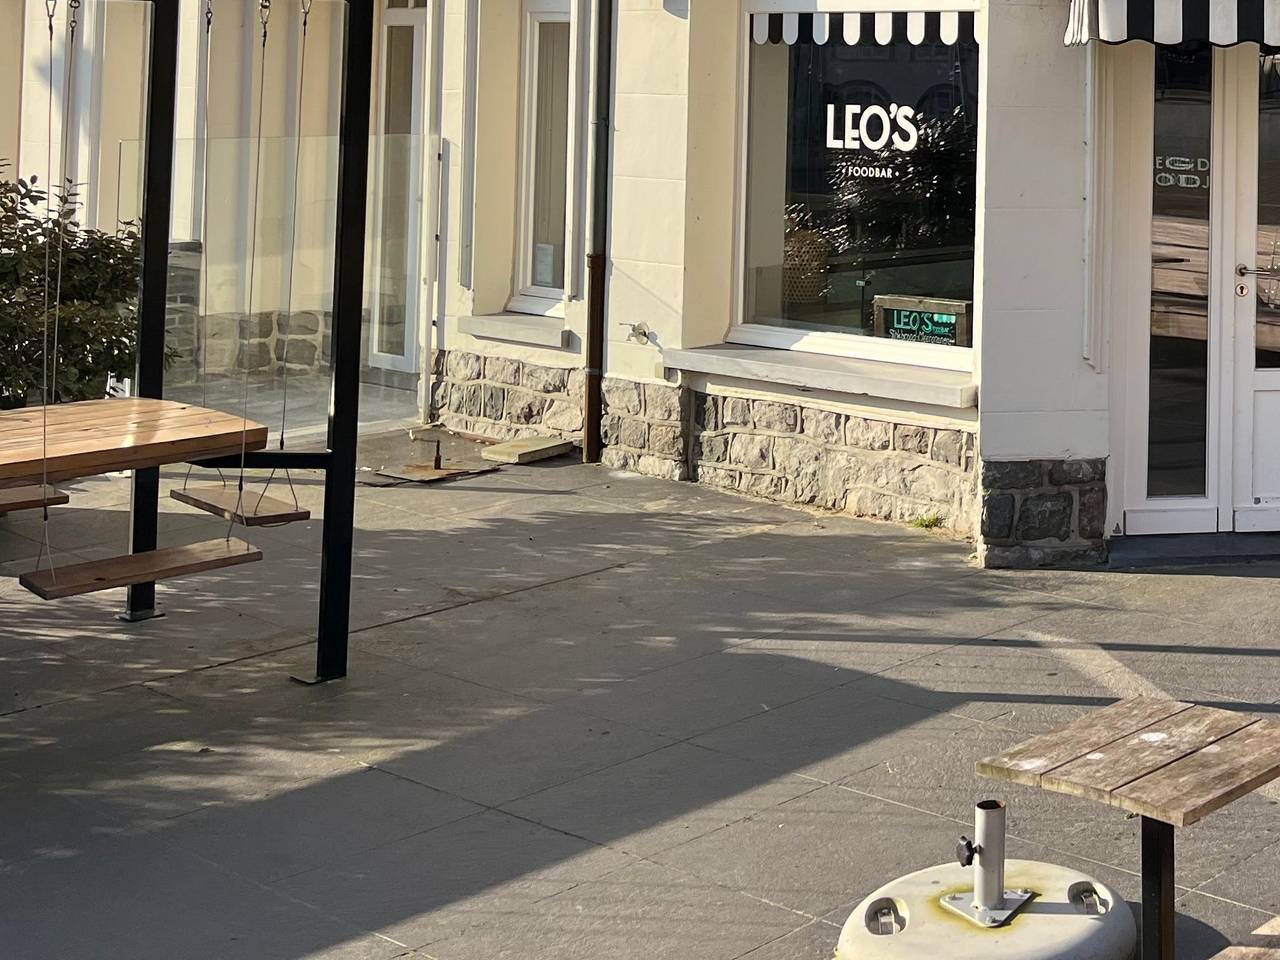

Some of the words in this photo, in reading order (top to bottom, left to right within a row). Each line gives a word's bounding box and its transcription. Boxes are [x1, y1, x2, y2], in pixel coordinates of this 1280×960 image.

[826, 103, 918, 151] LEO'S
[848, 166, 893, 179] FOODBAR
[894, 310, 933, 333] LEO'S
